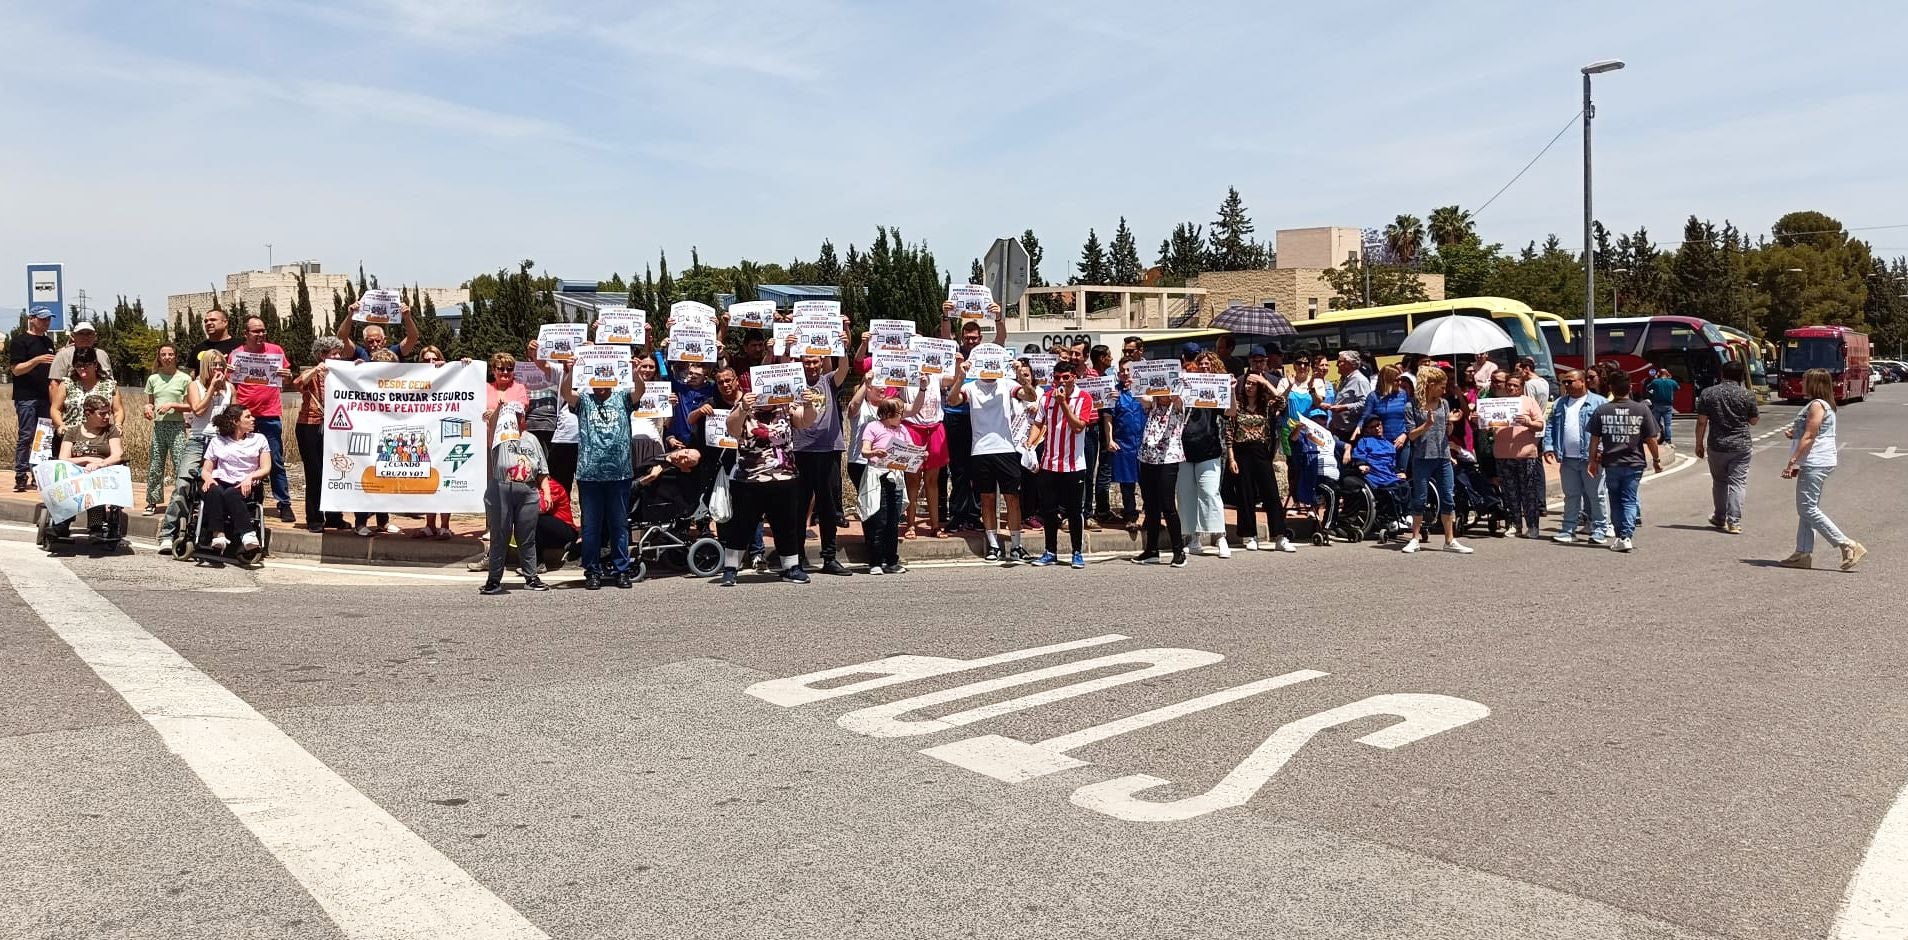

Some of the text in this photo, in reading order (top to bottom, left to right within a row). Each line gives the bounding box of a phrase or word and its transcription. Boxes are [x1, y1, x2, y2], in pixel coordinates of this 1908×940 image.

[378, 379, 431, 389] DESDE CEOM
[333, 389, 475, 402] QUEREMOS CRUZAR SEGUROS
[346, 401, 460, 413] ¡PASO DE PEATONES YA!
[1614, 408, 1630, 416] THE
[327, 481, 353, 491] ceom
[743, 633, 1492, 823] STOP
